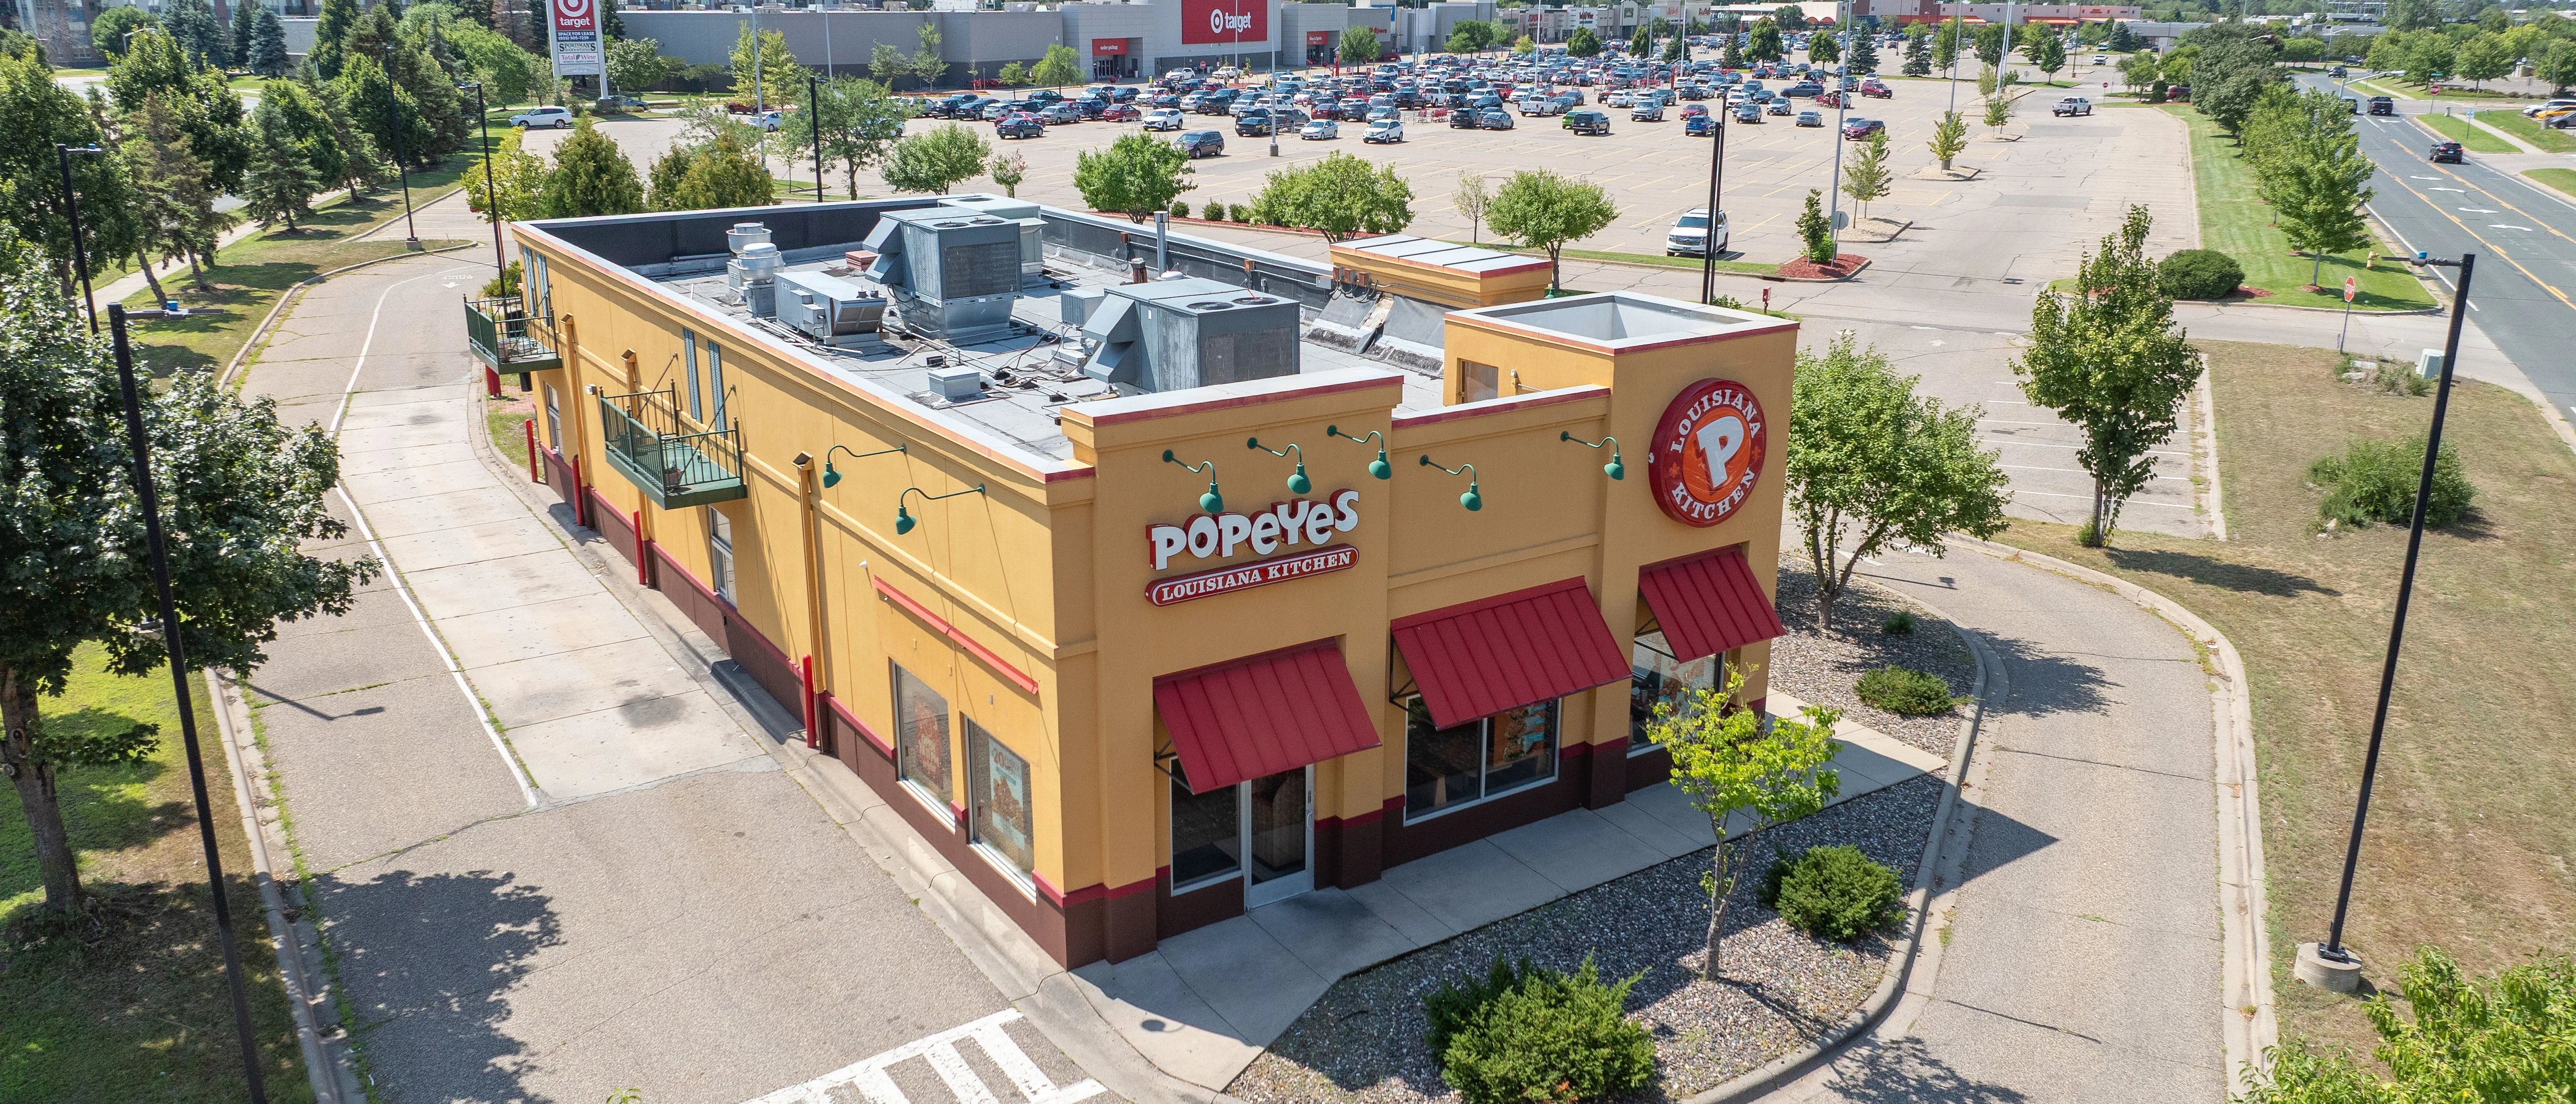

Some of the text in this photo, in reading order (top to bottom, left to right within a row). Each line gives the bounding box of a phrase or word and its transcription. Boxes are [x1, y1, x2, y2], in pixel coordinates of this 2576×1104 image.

[559, 17, 591, 28] target
[1224, 12, 1251, 33] target
[559, 43, 596, 52] SPORTSMAN'S
[2345, 283, 2354, 294] STOP
[1670, 389, 1761, 454] LOUISIANA
[1696, 416, 1744, 488] P
[1672, 467, 1755, 520] KITCHEN
[1161, 551, 1352, 601] LOUISIANA KITCHEN
